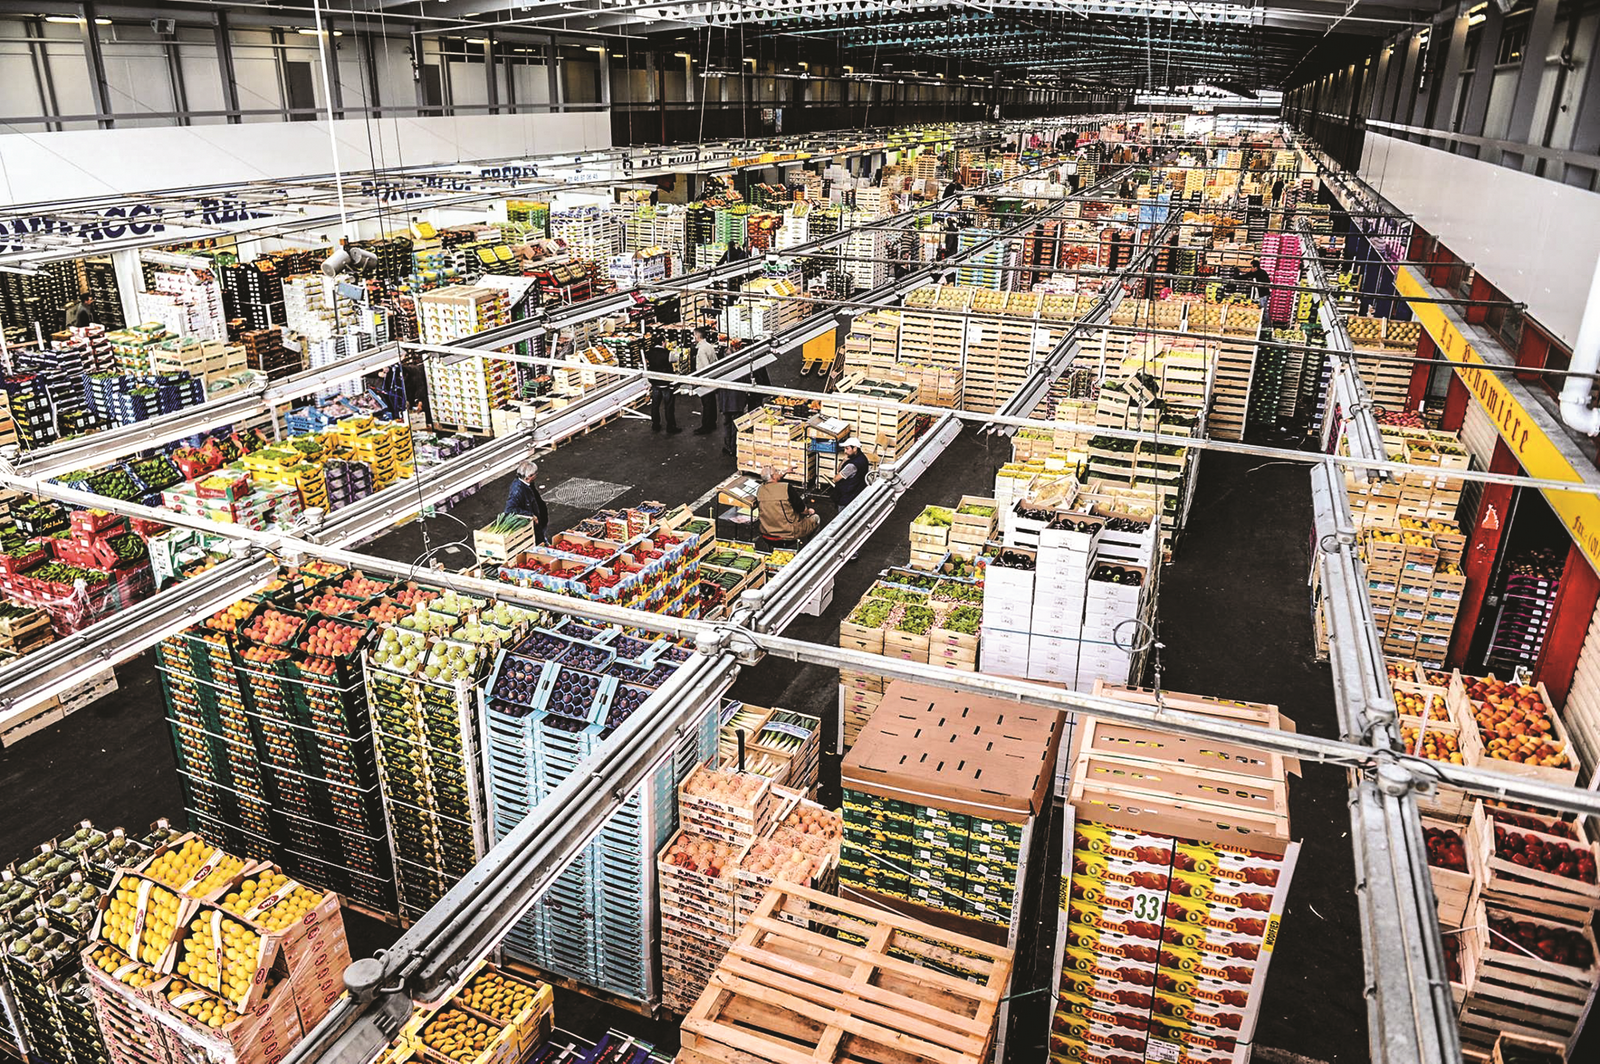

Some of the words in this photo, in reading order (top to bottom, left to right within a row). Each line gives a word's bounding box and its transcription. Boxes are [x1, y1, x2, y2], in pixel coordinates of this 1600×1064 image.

[1102, 844, 1135, 859] Zana
[1100, 870, 1133, 884] Zana
[1209, 865, 1244, 880] Zana
[1098, 894, 1130, 908] Zana
[1206, 891, 1239, 905] Zana
[1134, 893, 1160, 921] 33
[1095, 918, 1127, 932] Zana
[1202, 915, 1234, 930] Zana
[1265, 919, 1279, 946] MODIFIED
[1092, 941, 1124, 956] Zana
[1198, 940, 1230, 954] Zana
[1089, 964, 1121, 979] Zana
[1194, 963, 1226, 978] Zana
[1087, 987, 1118, 1002] Zana
[1191, 987, 1222, 1001] Zana
[1084, 1010, 1116, 1024] Zana
[1187, 1010, 1218, 1025] Zana
[1082, 1031, 1113, 1045] Zana
[1183, 1032, 1215, 1047] Zana
[1080, 1052, 1111, 1064] Zana
